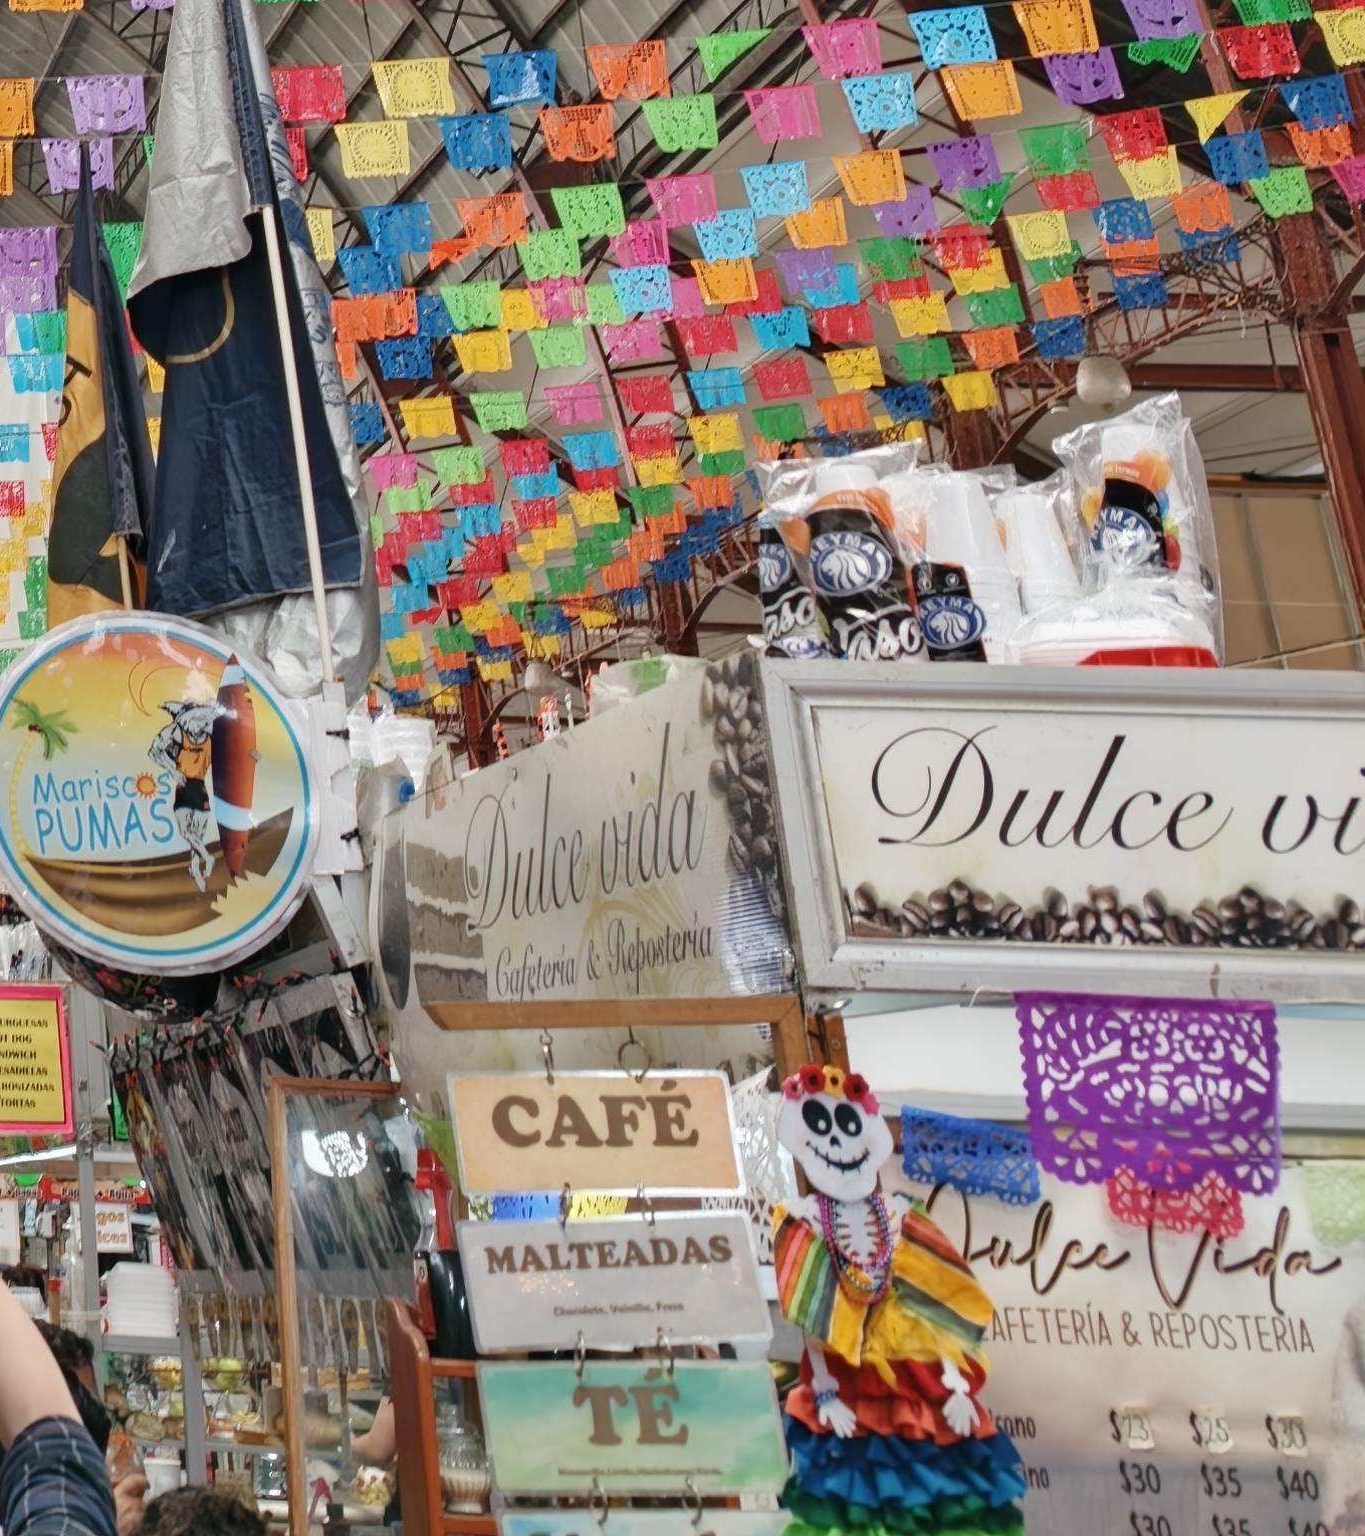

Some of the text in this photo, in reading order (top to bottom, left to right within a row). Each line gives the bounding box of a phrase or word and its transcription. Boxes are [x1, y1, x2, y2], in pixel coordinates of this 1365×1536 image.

[871, 725, 1365, 855] Dulce vi
[35, 798, 175, 855] PUMAS
[465, 722, 709, 930] Dulce vida
[491, 1079, 699, 1147] CAFÉ
[484, 1235, 733, 1274] MALTEADAS
[981, 1301, 1113, 1347] AFETERÍA
[1122, 1311, 1142, 1346] &
[573, 1368, 689, 1445] TÉ
[1120, 1461, 1162, 1495] $30
[1200, 1462, 1242, 1498] $35
[1277, 1465, 1320, 1501] $40
